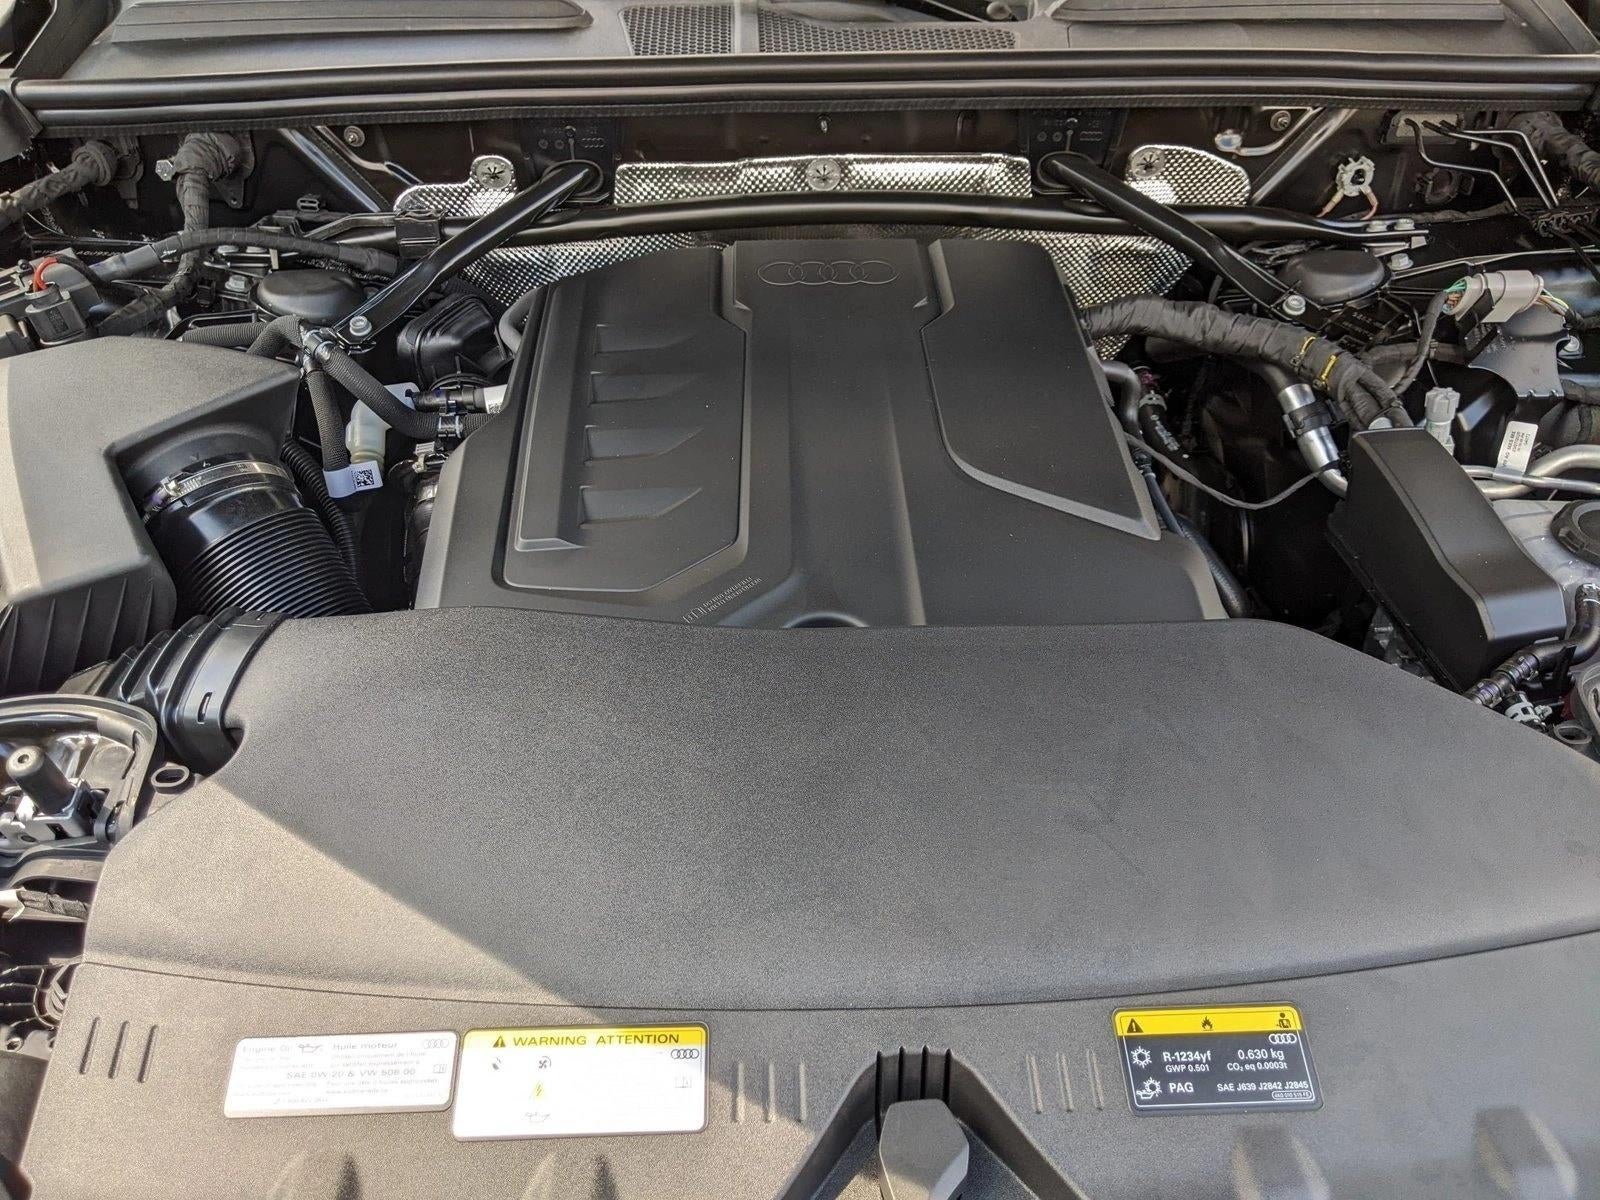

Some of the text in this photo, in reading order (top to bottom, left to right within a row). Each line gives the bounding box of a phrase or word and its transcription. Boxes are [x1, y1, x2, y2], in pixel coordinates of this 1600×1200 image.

[513, 1033, 680, 1046] WARNING ATTENTION
[332, 1043, 358, 1051] Huile
[1162, 1051, 1211, 1063] R-1234yf
[1238, 1049, 1285, 1061] 0.630 kg
[1165, 1064, 1210, 1073] GWP 0.501
[1245, 1063, 1256, 1072] eq
[1257, 1062, 1288, 1071] 0.0003t
[360, 1069, 376, 1077] VW
[1168, 1082, 1194, 1093] PAG
[1217, 1081, 1309, 1092] SAE J639 J2842 J2845
